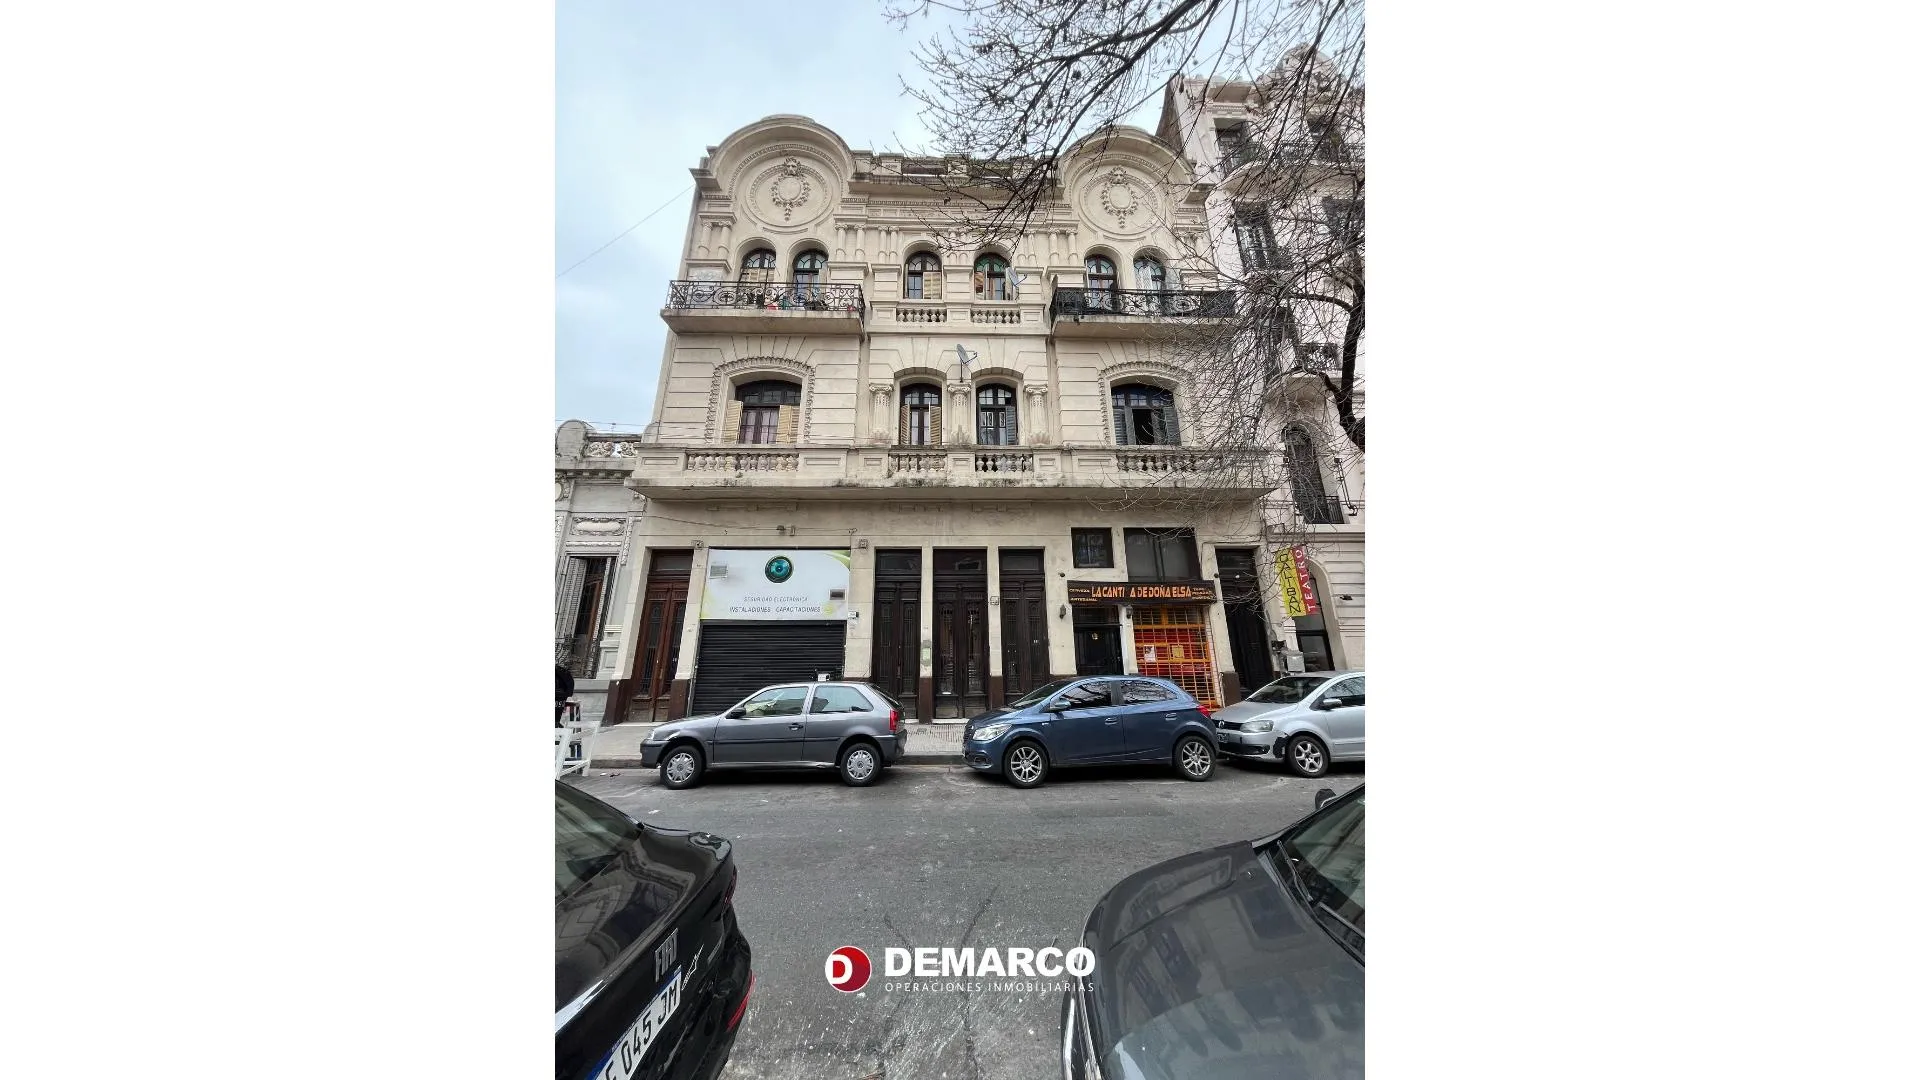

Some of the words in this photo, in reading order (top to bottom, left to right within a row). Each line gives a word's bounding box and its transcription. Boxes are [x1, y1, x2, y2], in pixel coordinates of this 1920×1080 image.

[1091, 585, 1102, 598] LA
[1137, 586, 1148, 598] DE
[1148, 584, 1171, 598] DOÑA
[1172, 586, 1192, 598] ELSA
[1295, 549, 1316, 612] TEATRO
[621, 1009, 652, 1075] 045
[657, 979, 679, 1026] JM
